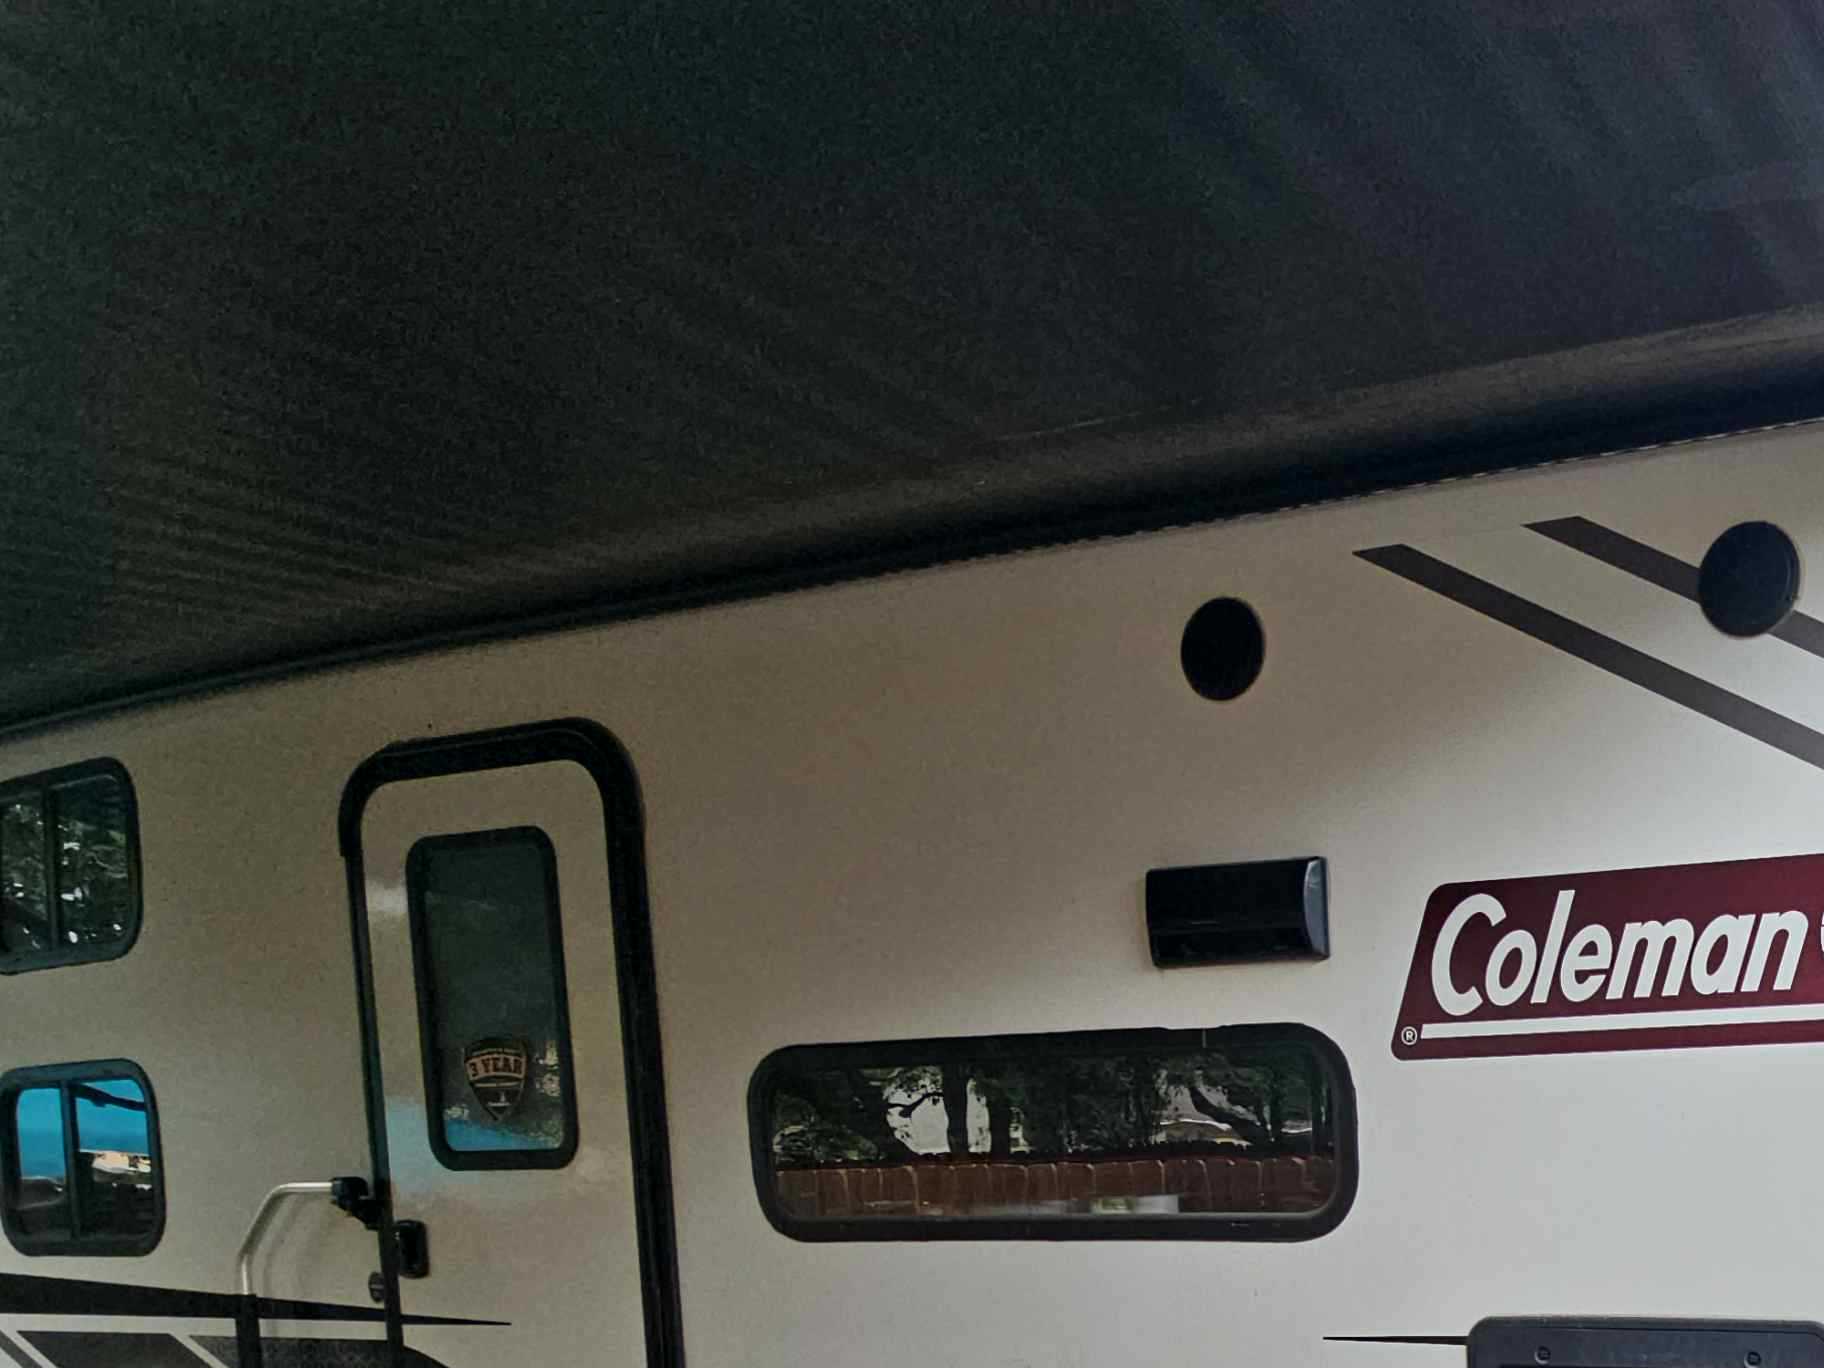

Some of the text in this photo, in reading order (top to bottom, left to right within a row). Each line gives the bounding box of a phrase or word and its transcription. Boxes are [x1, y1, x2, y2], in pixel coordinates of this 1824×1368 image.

[1431, 888, 1810, 1017] Coleman
[469, 1055, 523, 1078] 3 YEAR
